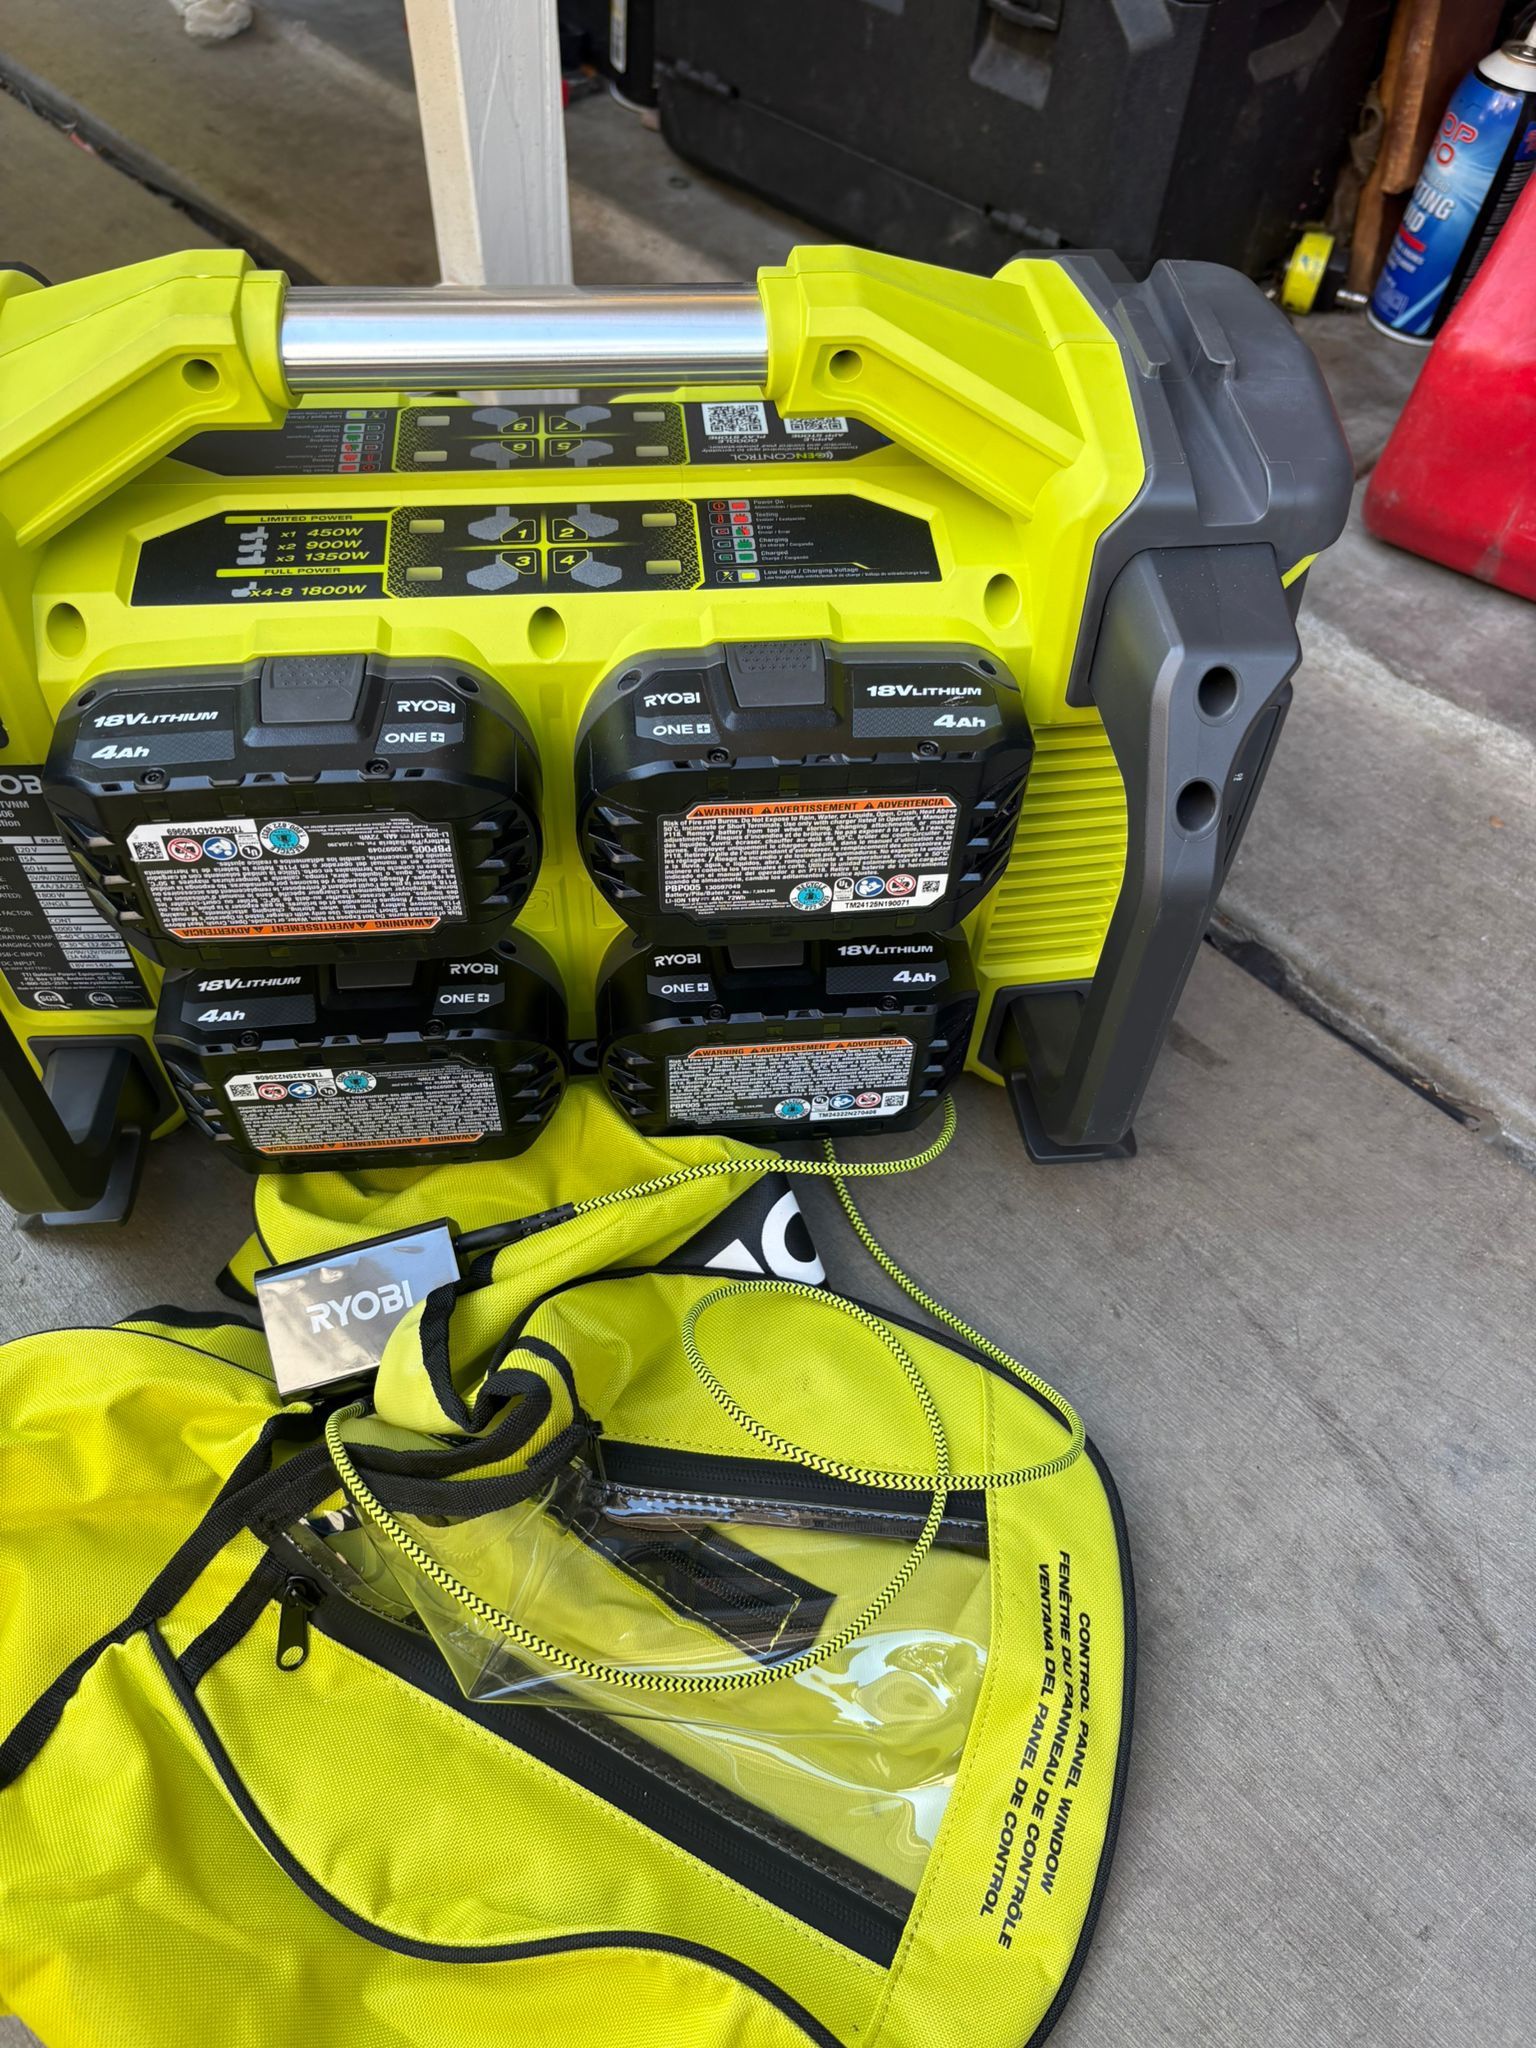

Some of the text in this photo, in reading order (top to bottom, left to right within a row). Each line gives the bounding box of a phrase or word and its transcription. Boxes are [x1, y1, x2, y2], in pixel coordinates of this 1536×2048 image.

[306, 528, 364, 537] 450W
[518, 529, 528, 539] 1
[558, 528, 576, 538] 2
[305, 540, 362, 550] 900W
[305, 552, 370, 562] 1350W
[514, 556, 532, 567] 3
[560, 554, 576, 565] 4
[250, 584, 368, 598] x4-8 1800W
[644, 692, 700, 708] RYOBI
[397, 700, 456, 714] RYOBI
[934, 714, 986, 728] 4Ah
[91, 744, 150, 760] 4Ah
[704, 798, 944, 816] WARNING AVERTISSEMENT ADVERTENCIA
[411, 844, 451, 853] PBP005
[664, 883, 701, 892] PBP005
[181, 919, 423, 936] WARNING AVERTISSEMENT ADVERTENCIA
[654, 952, 702, 968] RYOBI
[450, 963, 498, 976] RYOBI
[892, 970, 936, 982] 4Ah
[197, 1008, 246, 1022] 4Ah
[760, 1044, 830, 1052] AVERTISSEMENT
[847, 1040, 902, 1048] ADVERTENCIA
[267, 1143, 325, 1151] ADVERTENCIA
[342, 1138, 412, 1147] AVERTISSEMENT
[306, 1280, 414, 1334] RYOBI
[979, 1563, 1056, 1918] VENTANA DEL PANEL DE CONTROL
[998, 1550, 1074, 1950] FENÊTRE DU PANNEAU DE CONTRÔLE
[1040, 1612, 1091, 1896] CONTROL PANEL WINDOW
